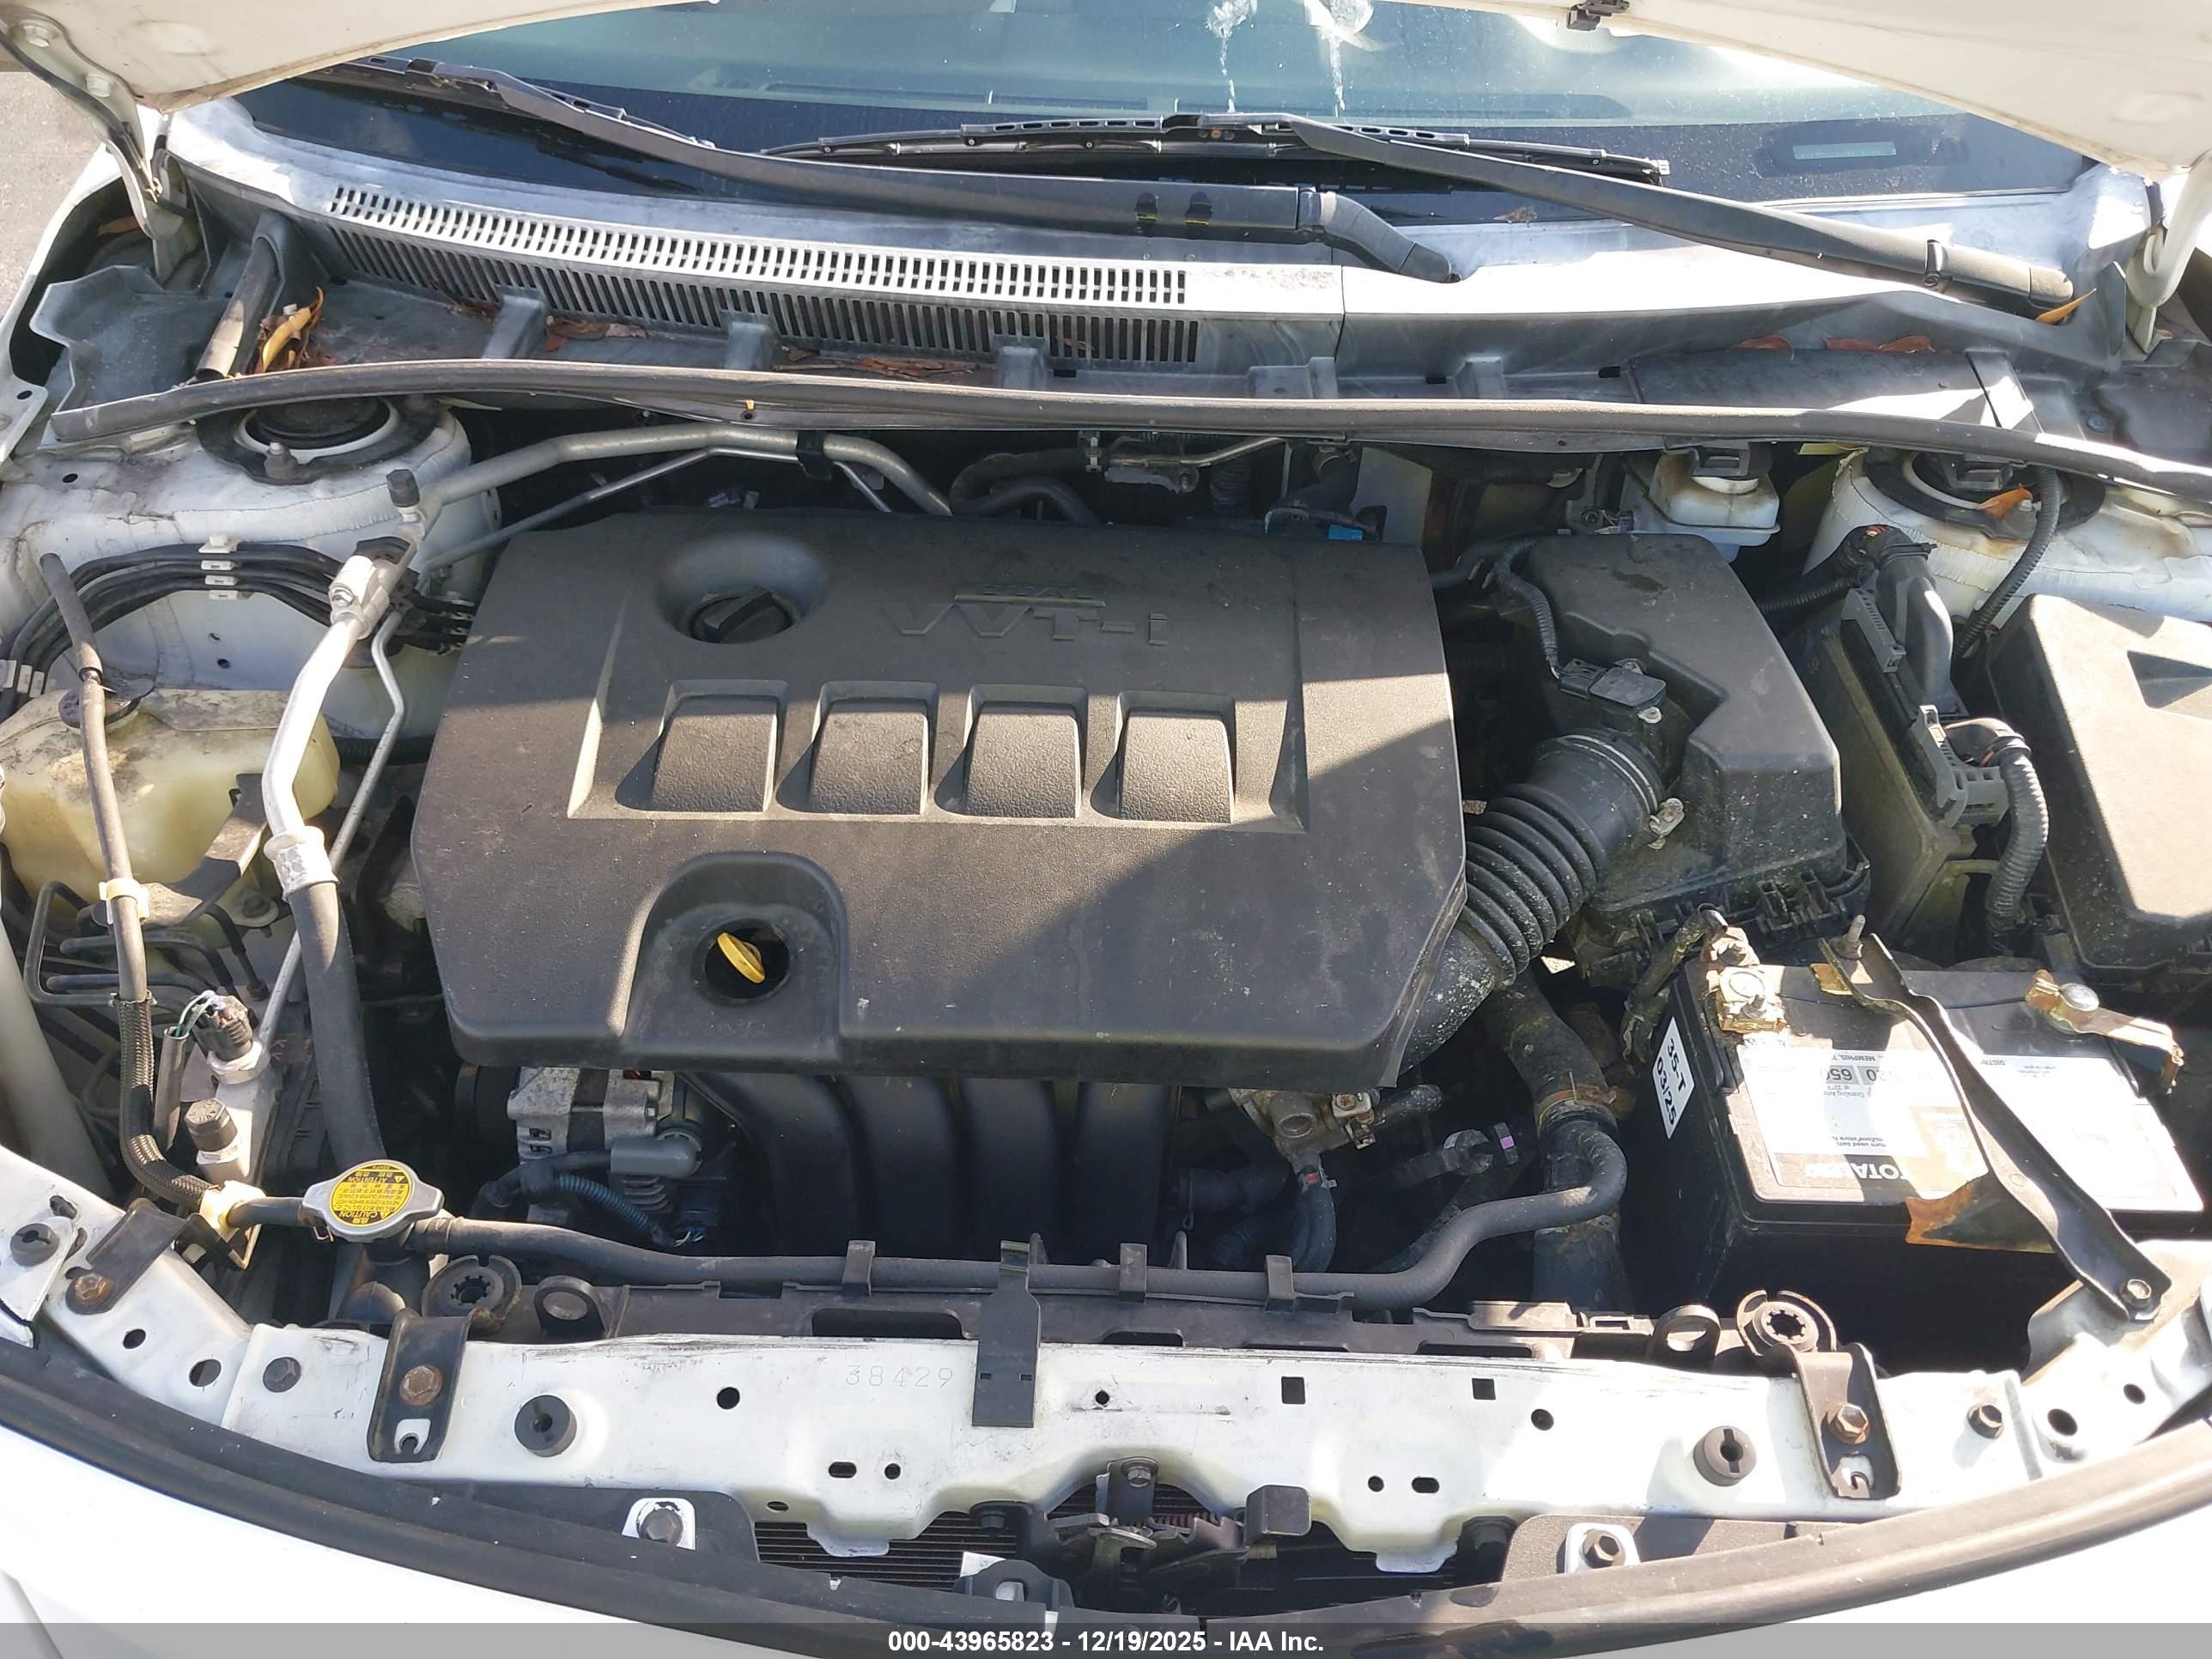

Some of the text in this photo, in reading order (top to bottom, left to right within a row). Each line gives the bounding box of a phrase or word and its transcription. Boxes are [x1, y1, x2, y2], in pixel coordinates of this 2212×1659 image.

[1667, 1037, 1686, 1093] 35-T
[1656, 1056, 1677, 1126] 03/25
[339, 1210, 378, 1218] CAUTION
[845, 1364, 953, 1388] 38429
